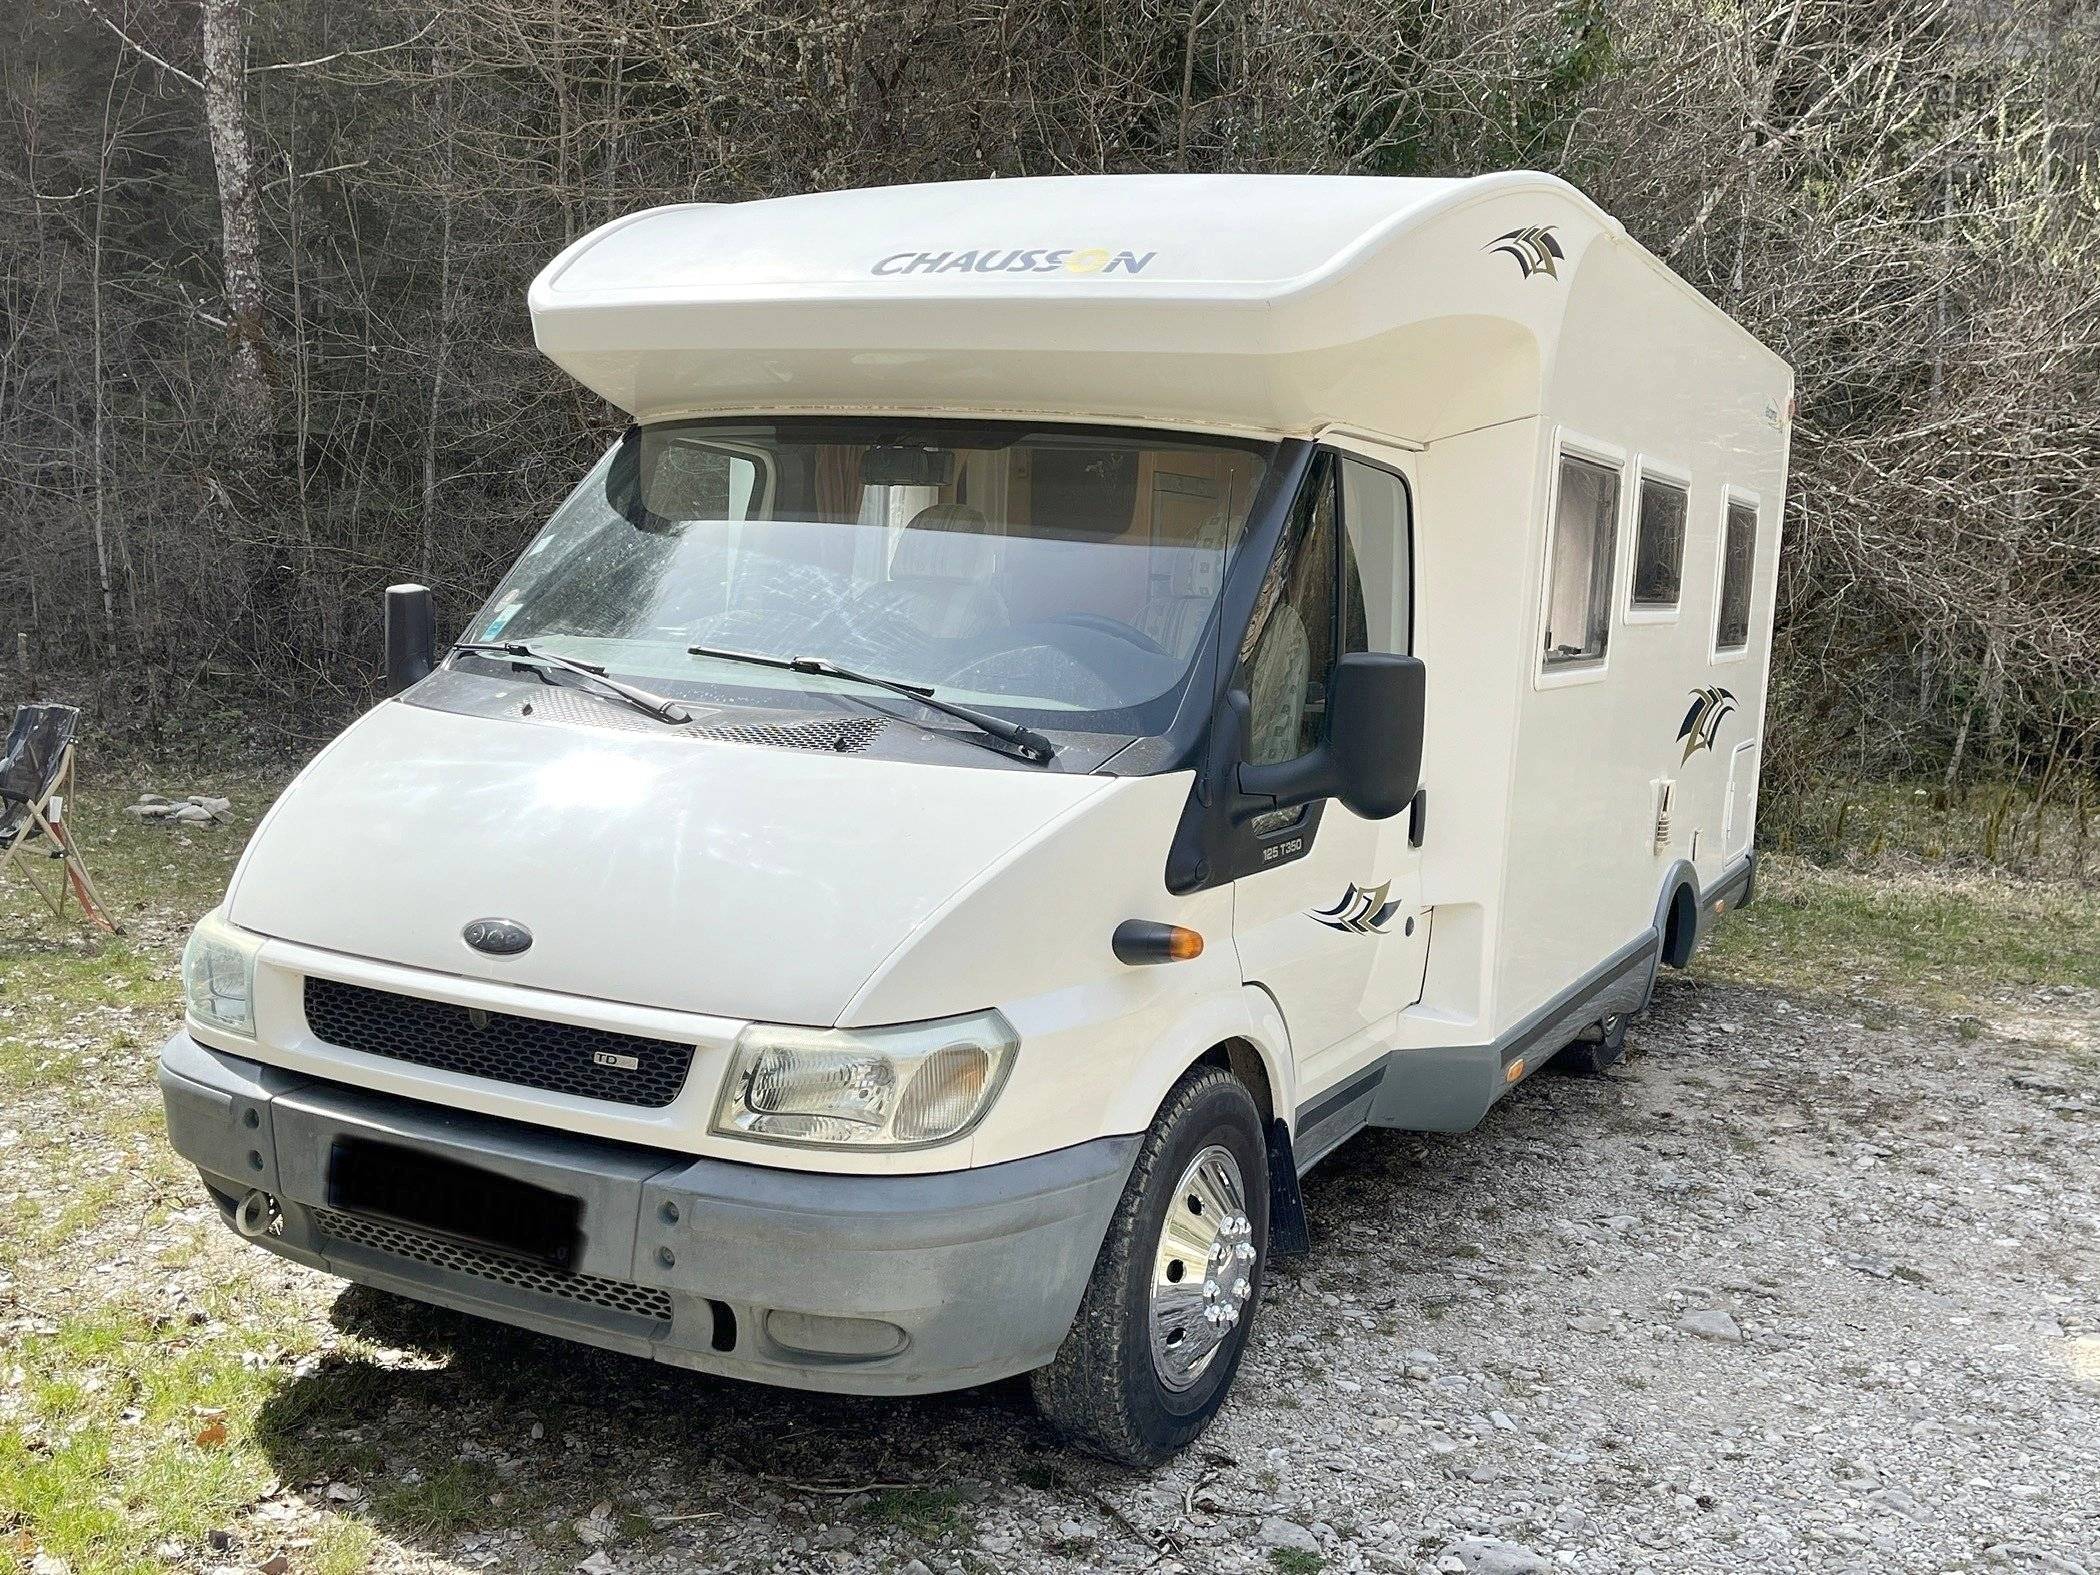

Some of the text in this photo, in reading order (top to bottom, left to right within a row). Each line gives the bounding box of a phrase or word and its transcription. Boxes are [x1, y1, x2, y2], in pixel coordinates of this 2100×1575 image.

[871, 248, 1157, 275] CHAUSSON
[1263, 838, 1302, 861] 125 T350
